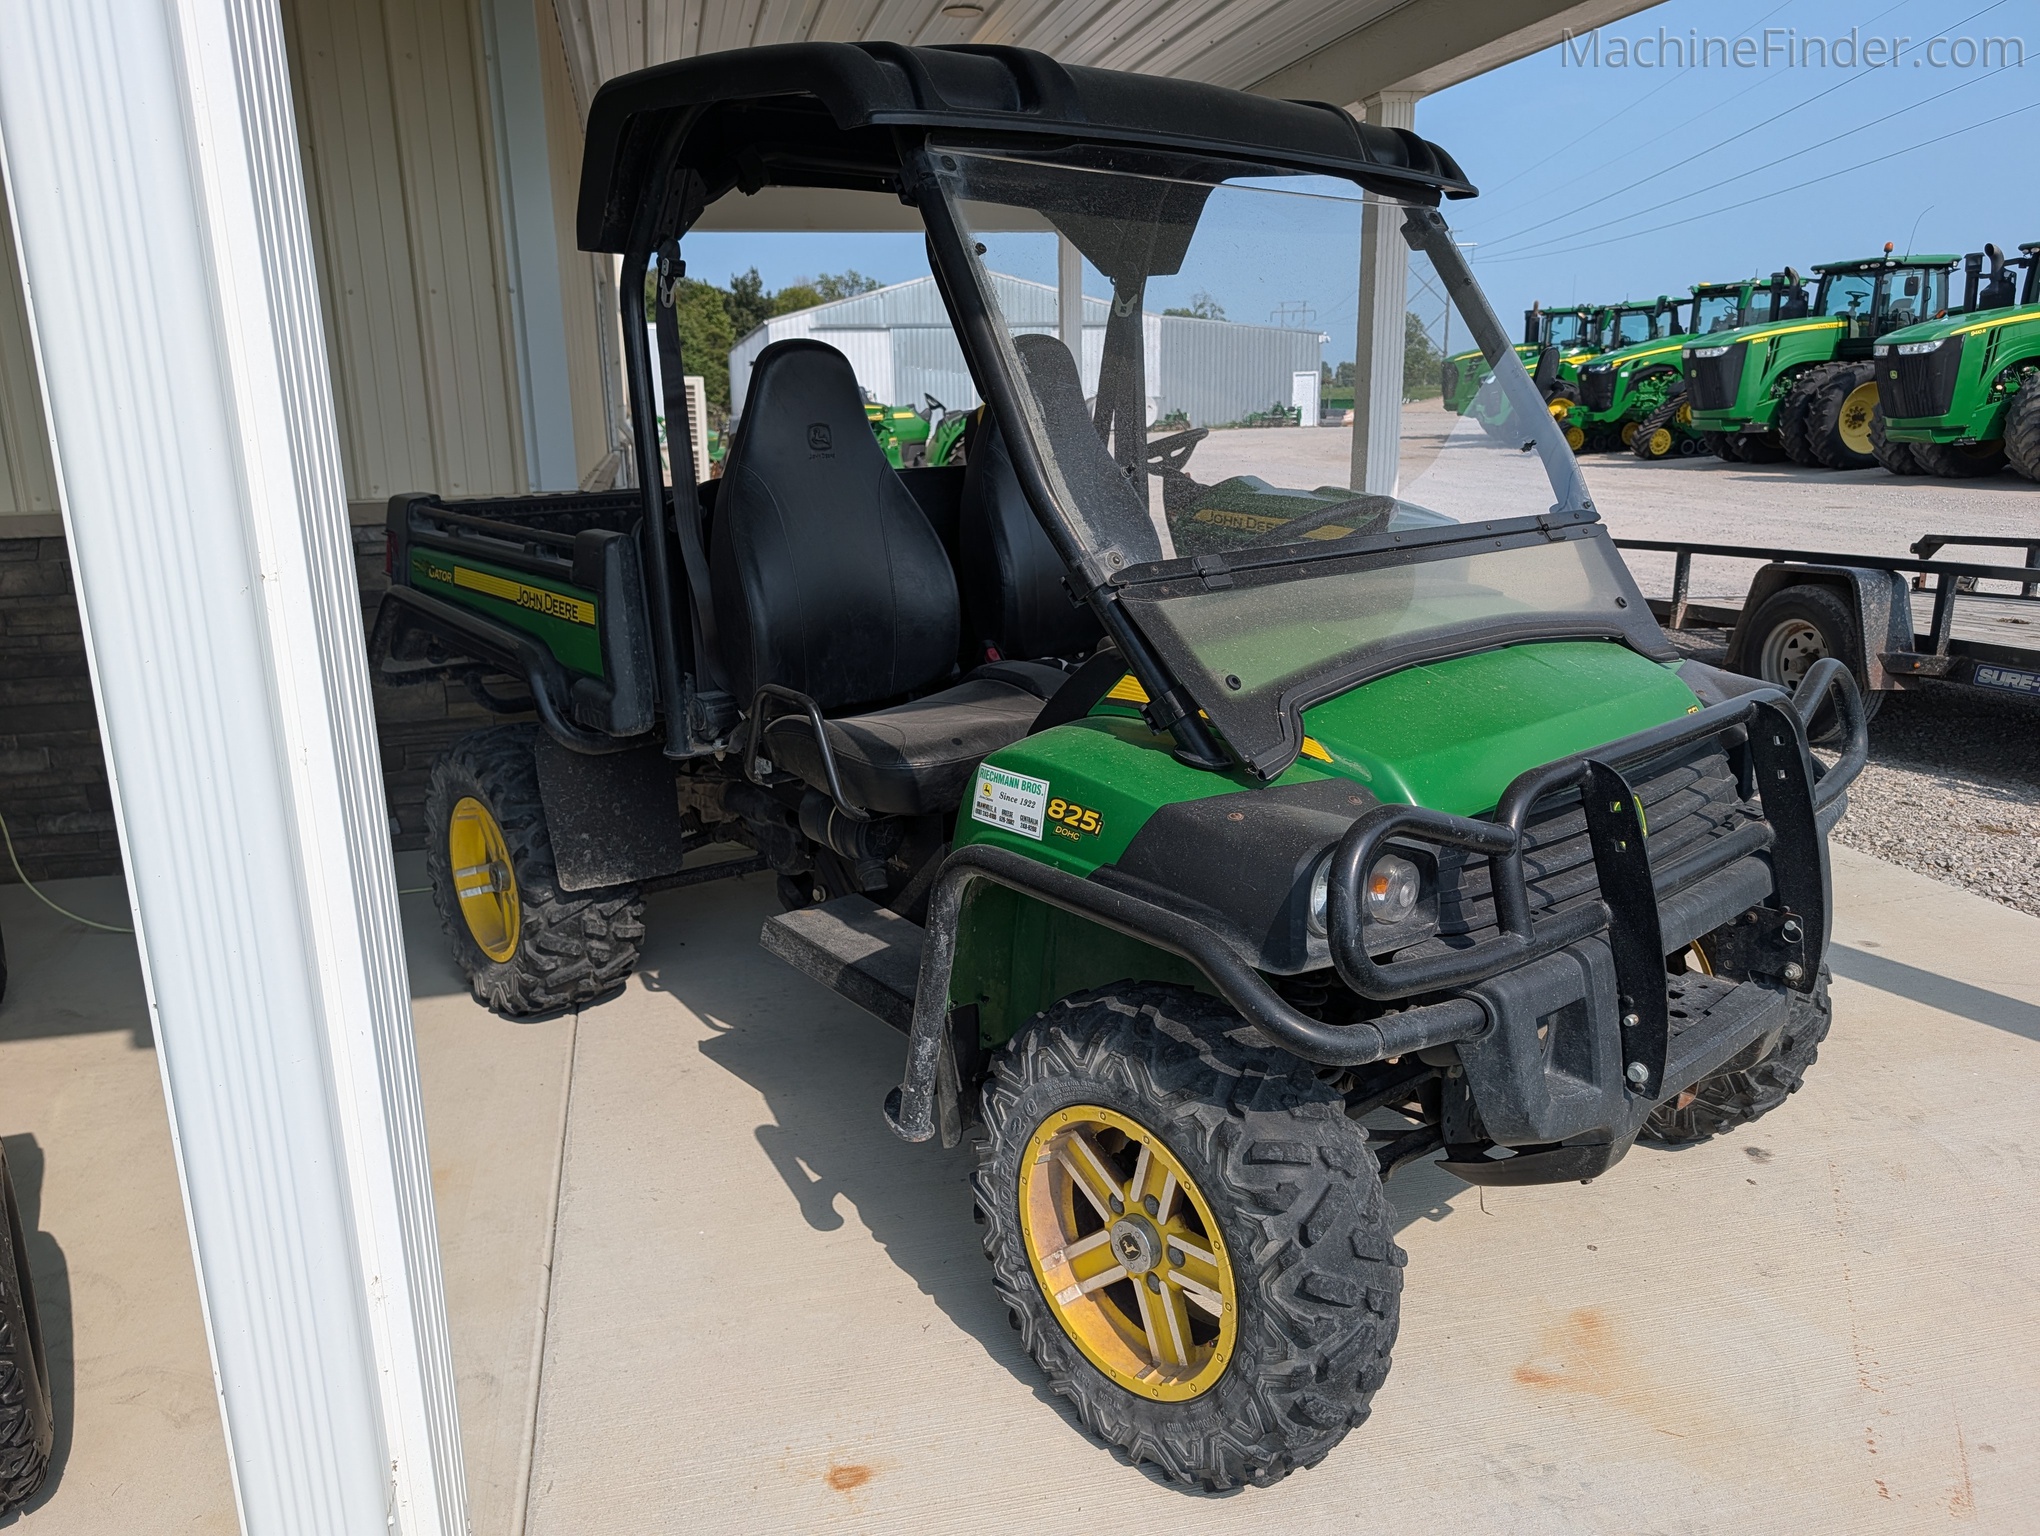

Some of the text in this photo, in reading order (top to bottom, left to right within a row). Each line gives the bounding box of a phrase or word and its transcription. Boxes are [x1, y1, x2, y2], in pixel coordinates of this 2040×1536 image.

[1205, 511, 1275, 532] JOHN DEE
[428, 565, 452, 584] GATOR
[516, 586, 579, 621] JOHN DEERE
[979, 767, 1044, 797] RIECHMANN BROS.
[998, 791, 1018, 804] Since
[1019, 797, 1037, 809] 1922
[1047, 798, 1102, 835] 825i
[1055, 825, 1080, 841] DOHC
